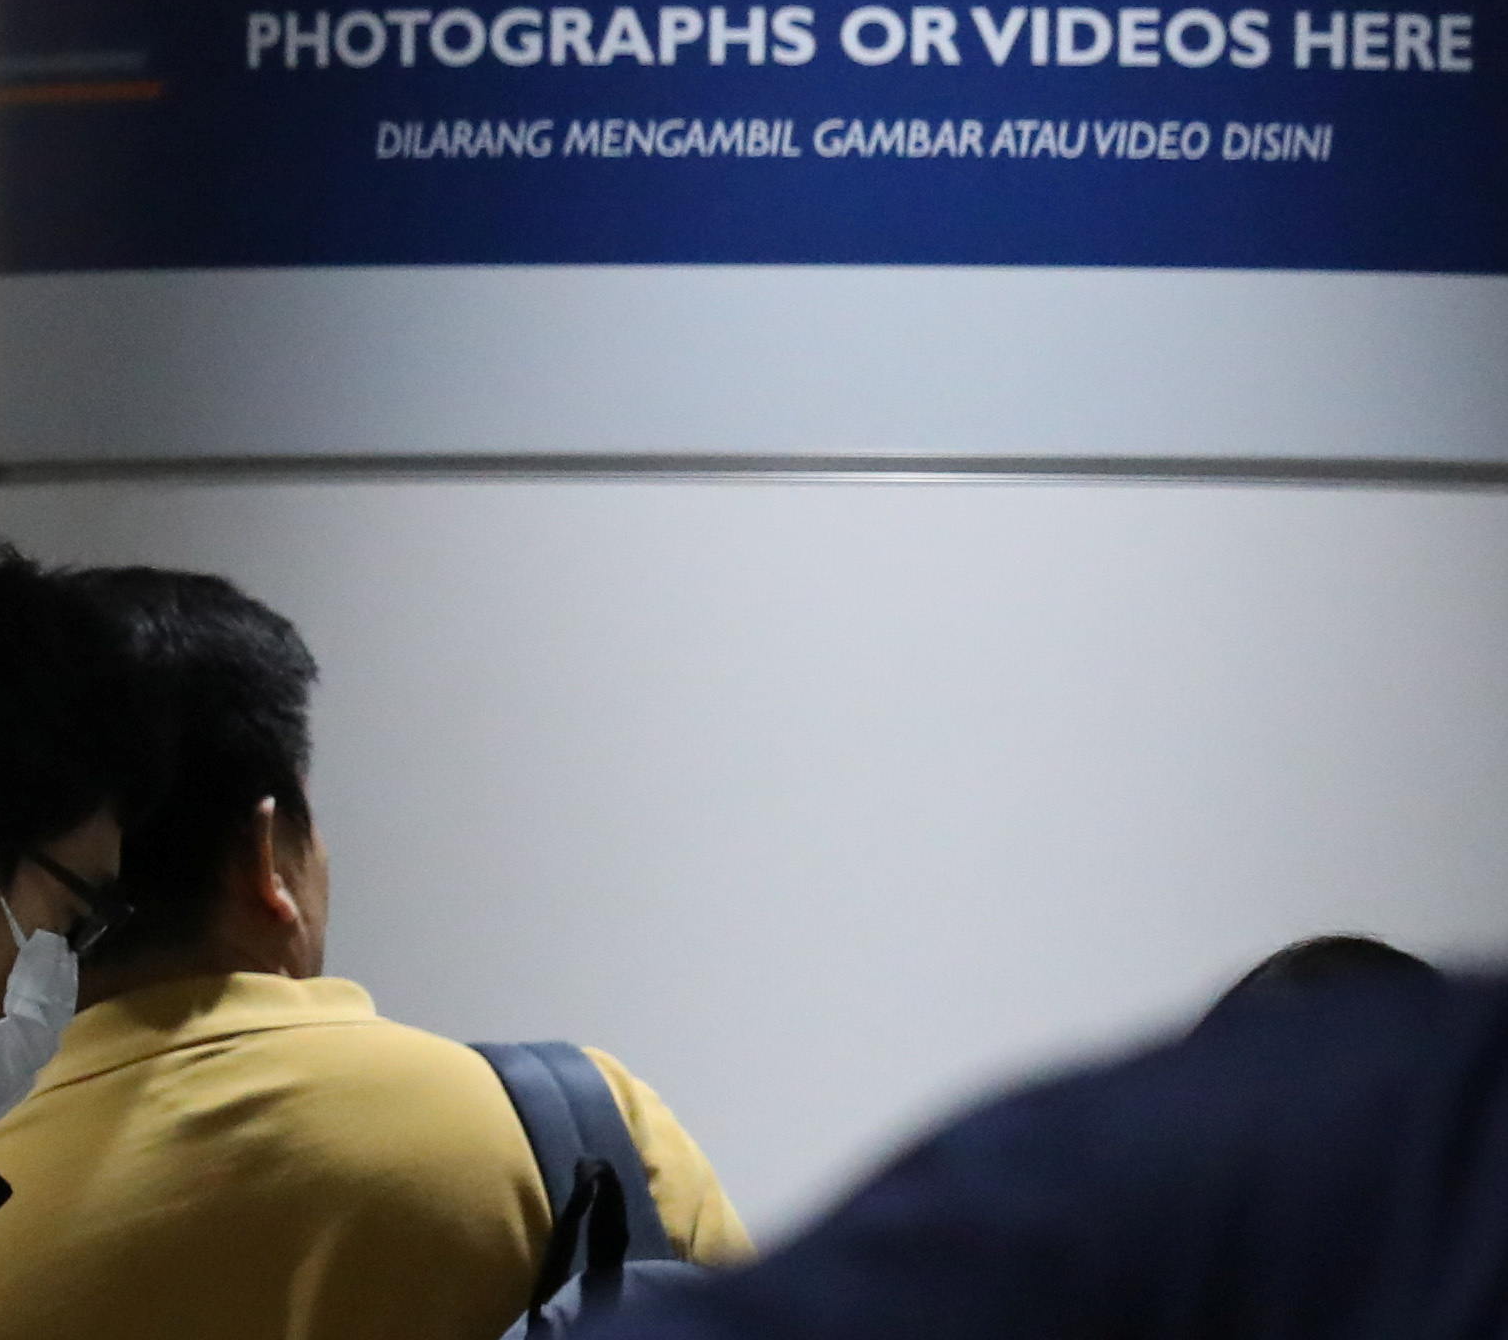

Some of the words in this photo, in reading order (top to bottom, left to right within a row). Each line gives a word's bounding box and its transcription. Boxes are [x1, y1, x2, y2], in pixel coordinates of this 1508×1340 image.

[247, 5, 818, 68] PHOTOGRAPHS
[838, 5, 962, 68] OR
[970, 6, 1272, 69] VIDEOS
[1293, 10, 1475, 71] HERE
[376, 118, 555, 159] DILARANG
[562, 117, 804, 159] MENGAMBIL
[811, 117, 981, 160] GAMBAR
[989, 118, 1090, 160] ATAU
[1092, 120, 1213, 161] VIDEO
[1221, 121, 1335, 162] DISINI
